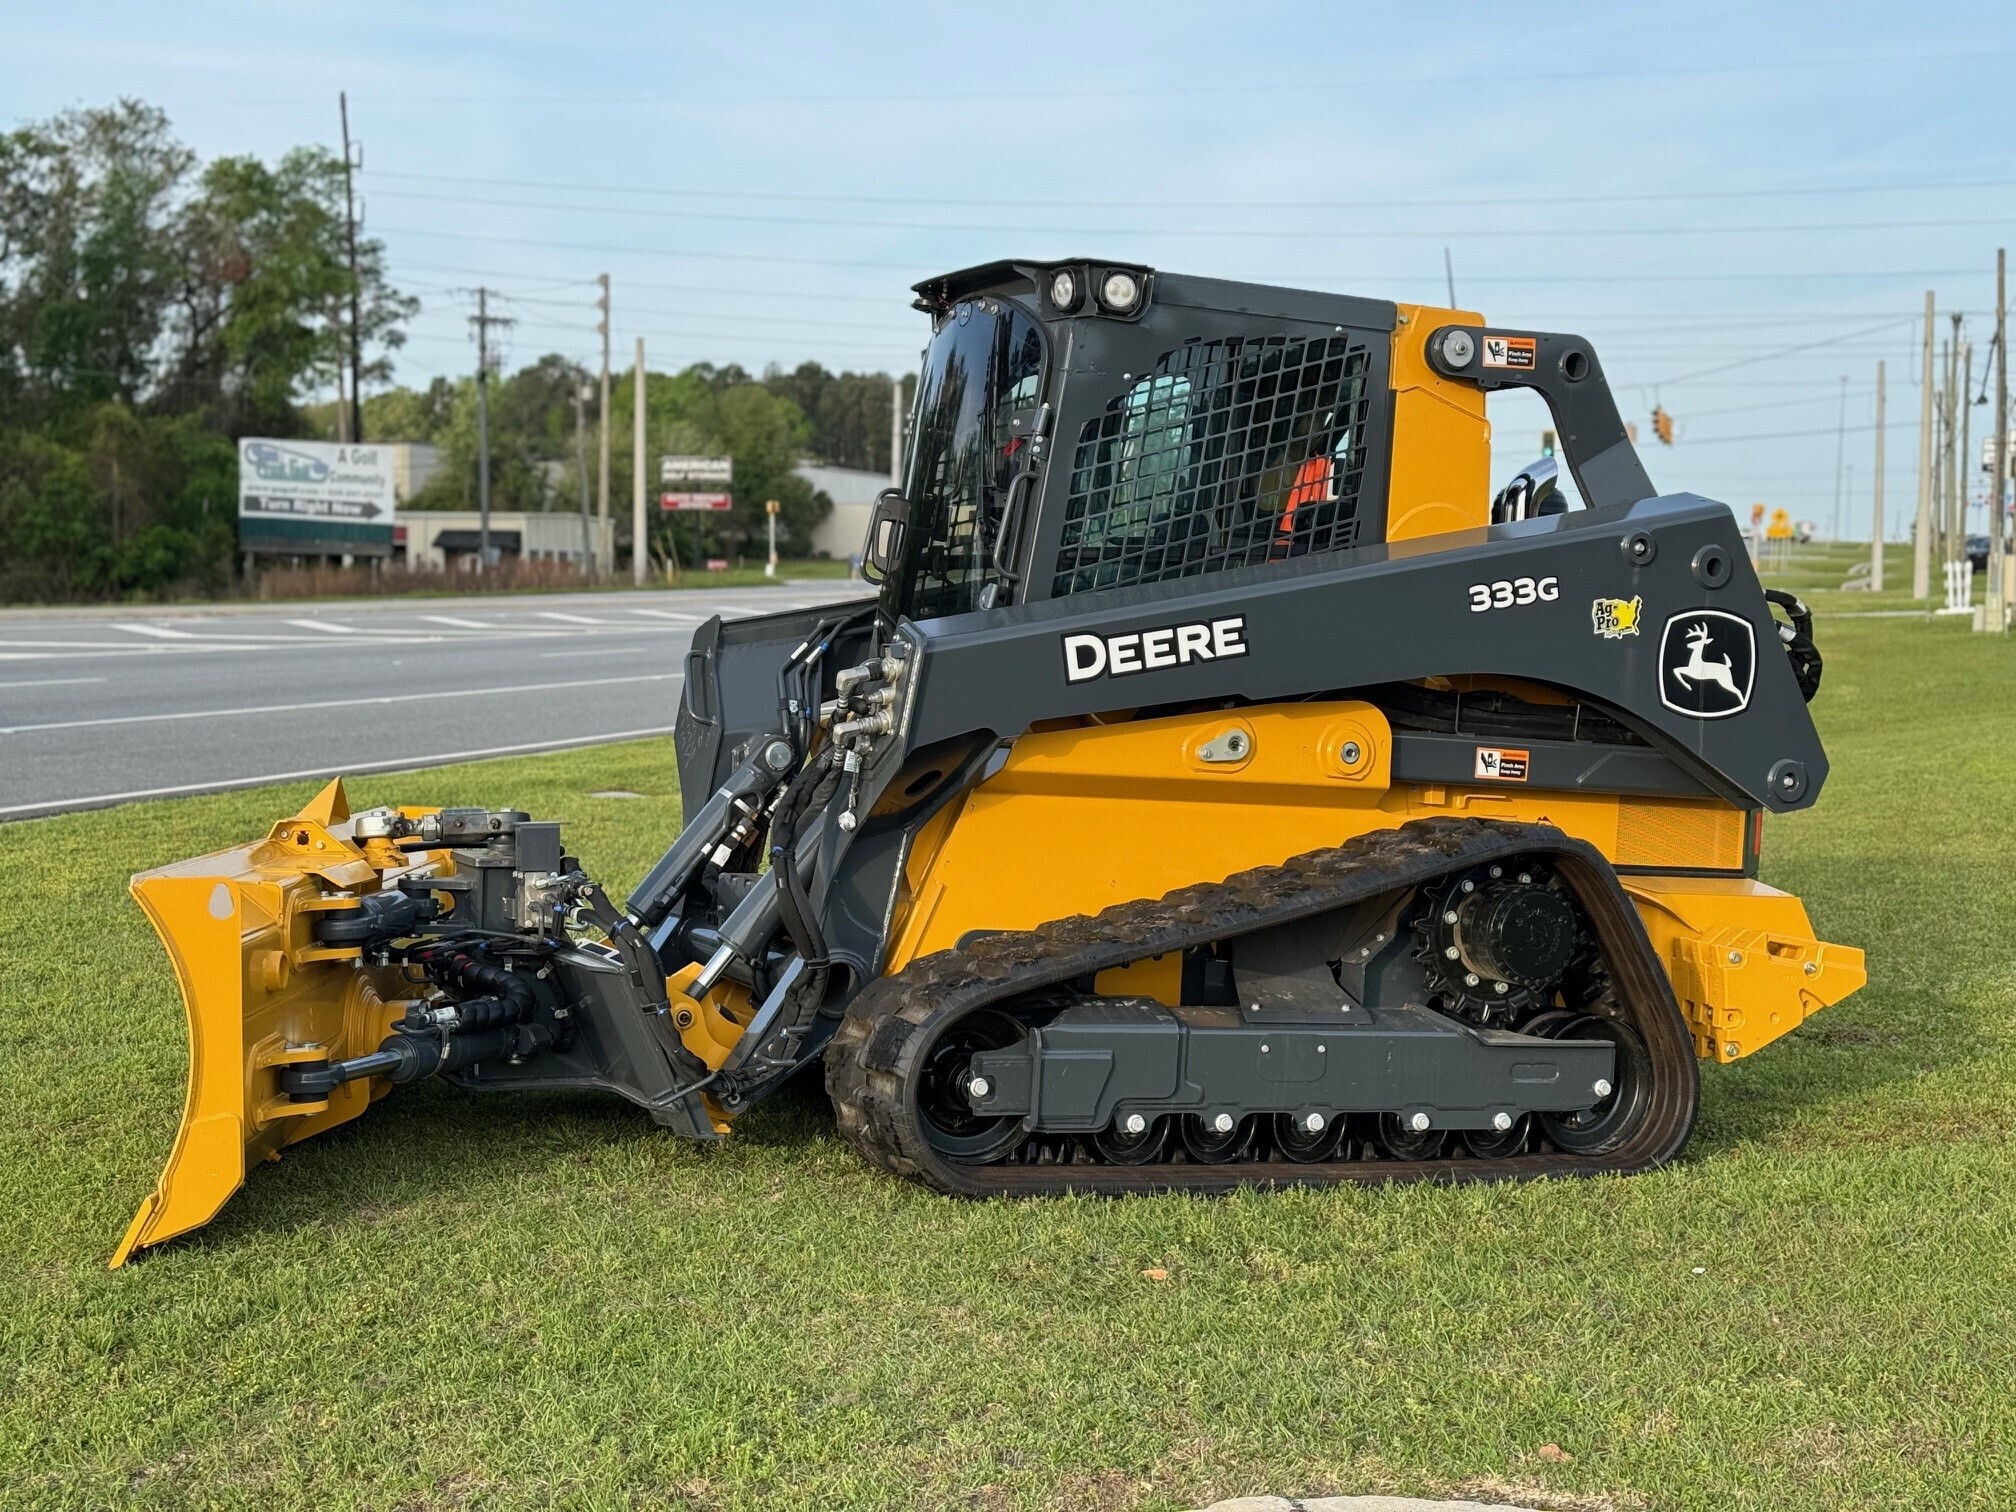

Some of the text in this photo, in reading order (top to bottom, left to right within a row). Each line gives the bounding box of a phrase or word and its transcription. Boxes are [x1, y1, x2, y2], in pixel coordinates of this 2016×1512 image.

[338, 448, 347, 464] A
[350, 449, 378, 466] Golf
[330, 469, 385, 489] Community
[258, 496, 362, 516] Turn Right Now
[1469, 577, 1560, 612] 333G
[1596, 602, 1617, 617] Ag-
[1597, 616, 1619, 630] Pro
[1063, 617, 1247, 682] DEERE
